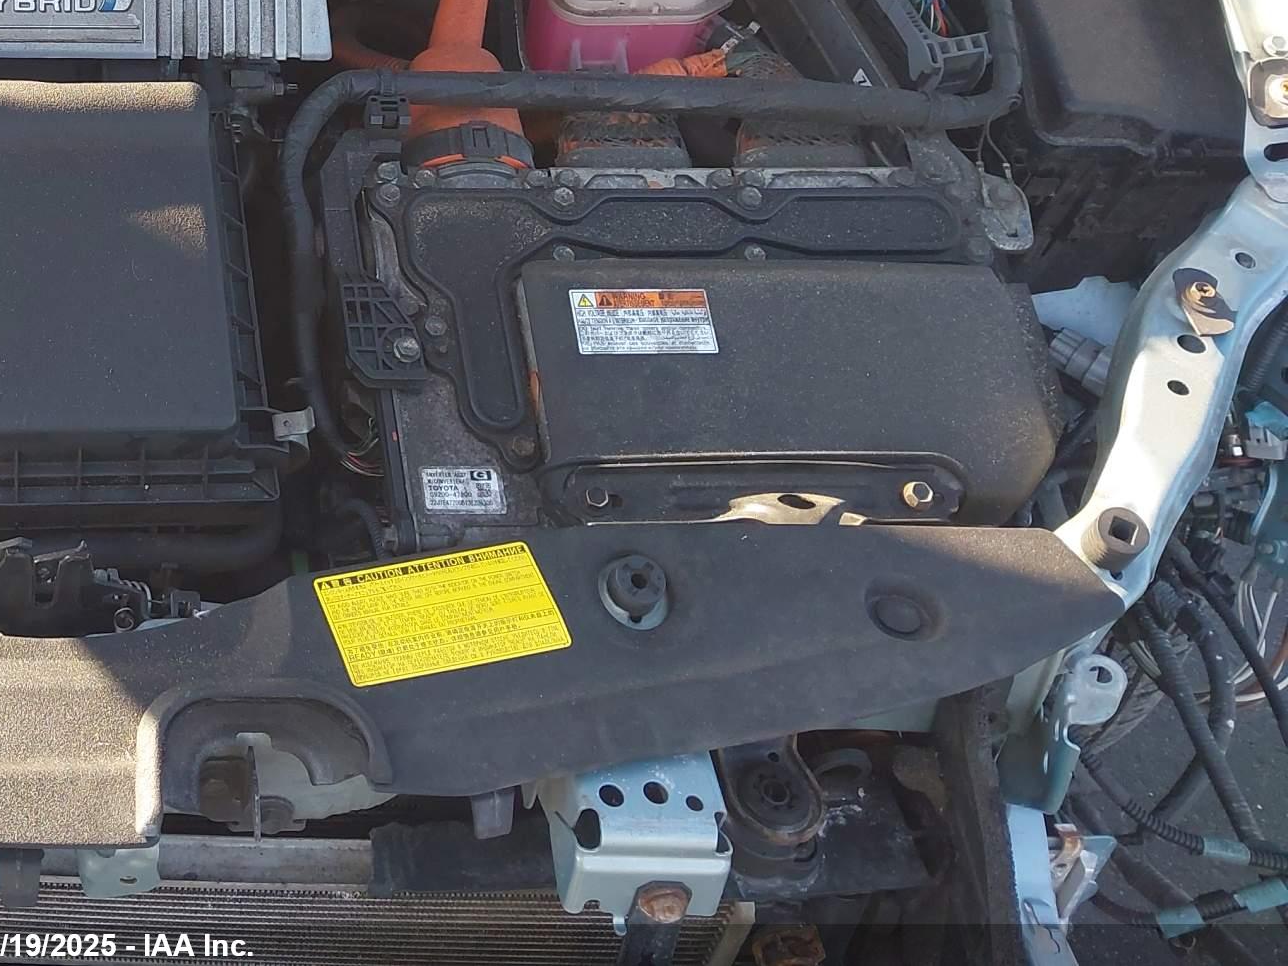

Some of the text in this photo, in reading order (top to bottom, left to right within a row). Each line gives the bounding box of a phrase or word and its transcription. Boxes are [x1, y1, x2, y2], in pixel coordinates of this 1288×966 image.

[469, 545, 525, 563] ВНИМАНИЕ
[356, 567, 403, 583] CAUTION
[407, 556, 465, 575] ATTENTION
